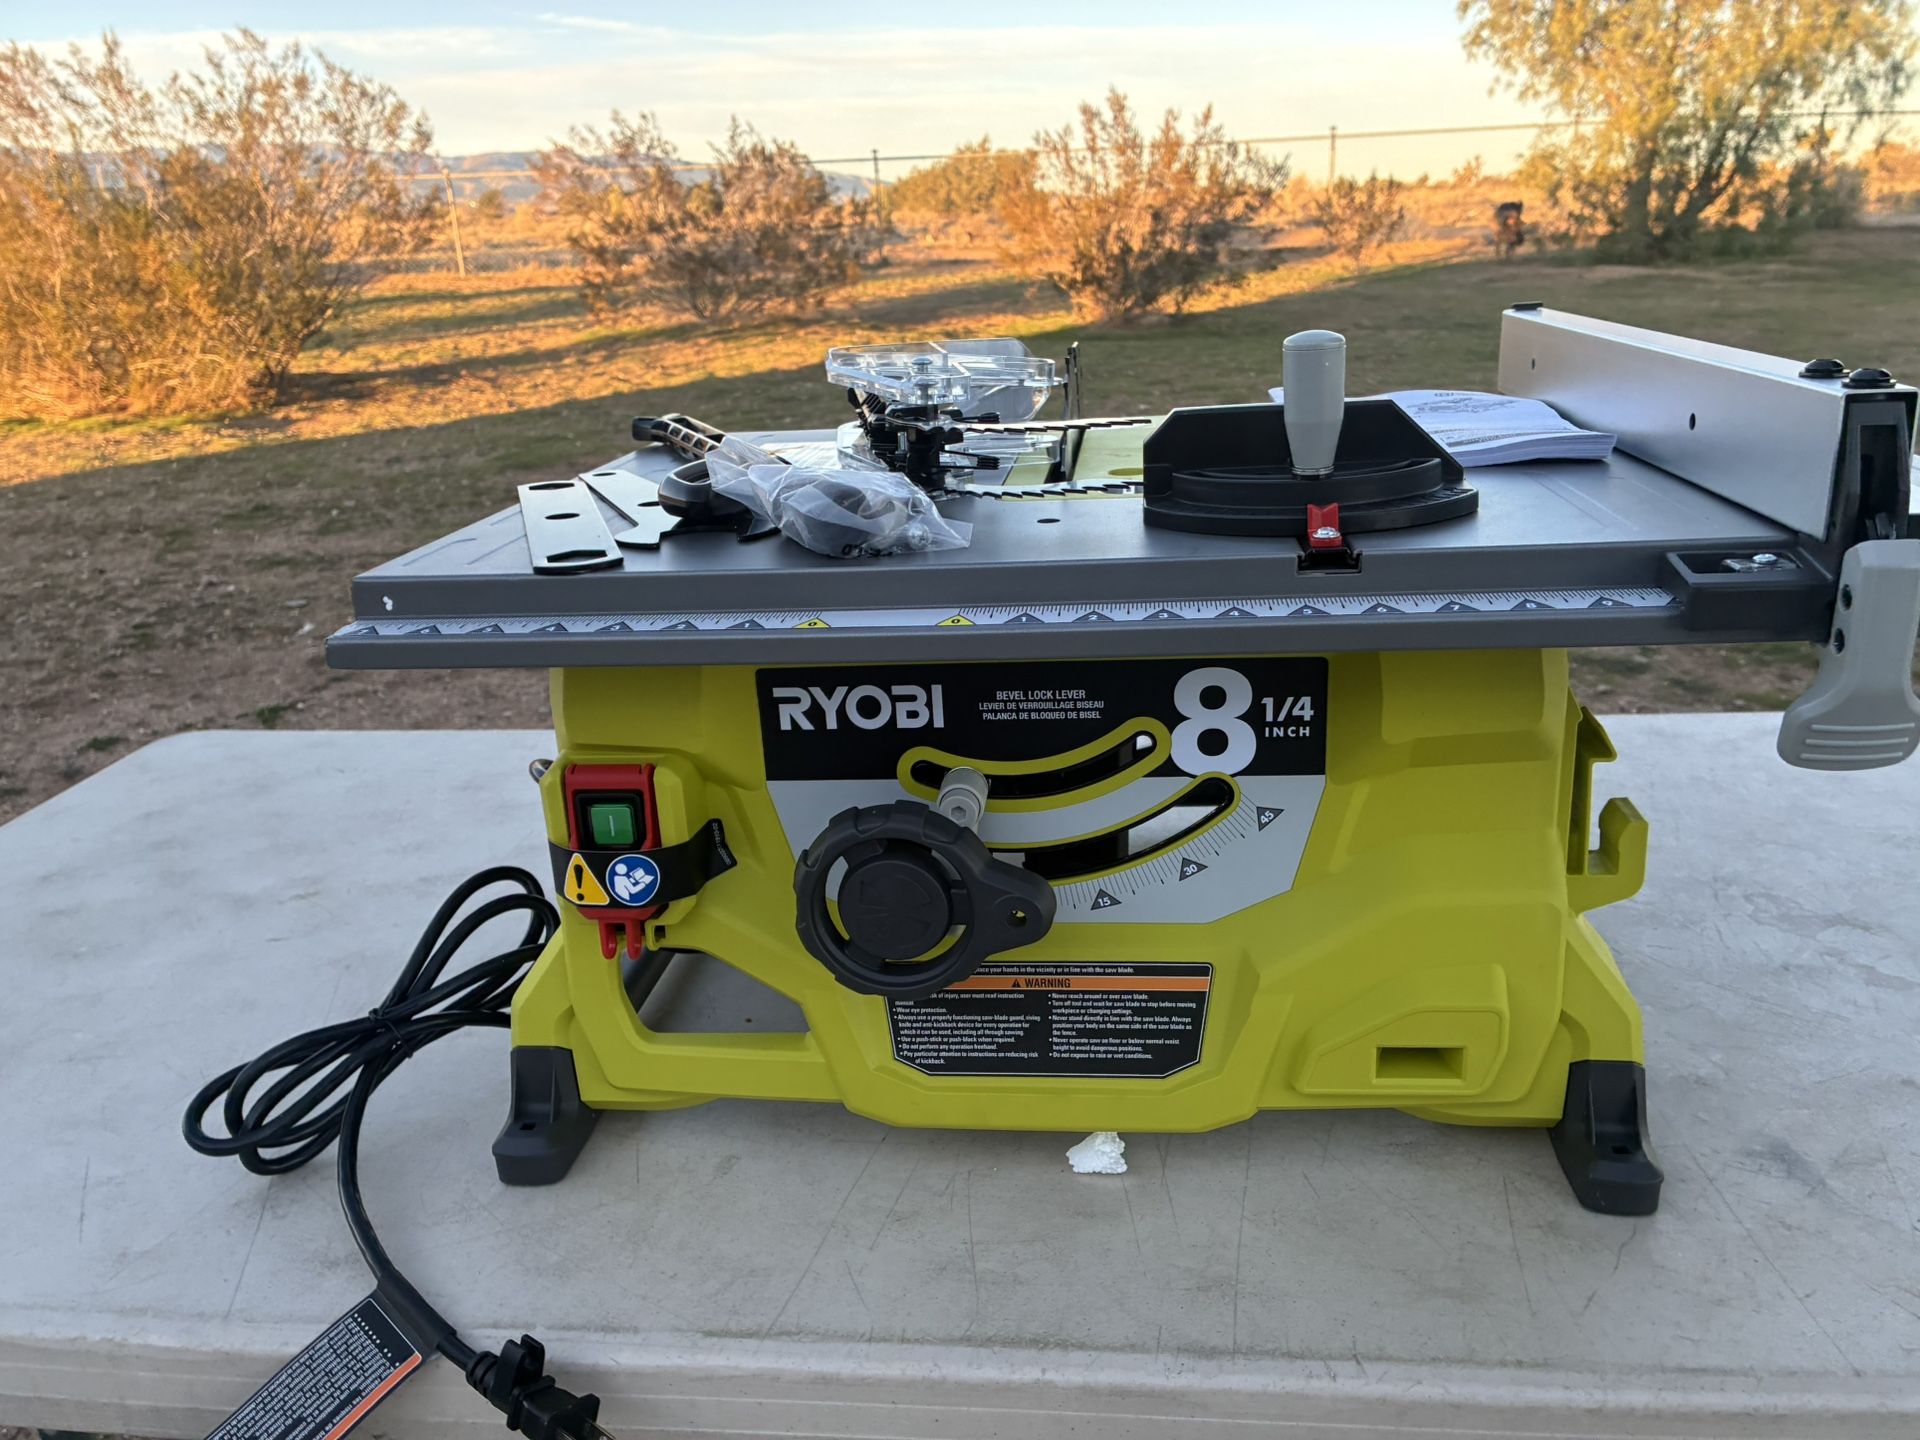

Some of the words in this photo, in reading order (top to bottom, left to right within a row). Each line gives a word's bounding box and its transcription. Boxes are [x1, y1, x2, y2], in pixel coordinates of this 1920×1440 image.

[996, 691, 1026, 700] BEVEL
[1028, 690, 1054, 700] LOCK
[1056, 689, 1086, 699] LEVER
[772, 685, 944, 731] RYOBI
[979, 702, 1004, 710] LEVIER
[1006, 702, 1017, 710] DE
[1018, 701, 1075, 709] VERROUILLAGE
[1076, 701, 1104, 709] BISEAU
[983, 712, 1017, 720] PALANCA
[1019, 712, 1029, 720] DE
[1031, 712, 1066, 720] BLOQUEO
[1067, 711, 1078, 719] DE
[1079, 711, 1102, 719] BISEL
[1170, 668, 1257, 777] 8
[1262, 696, 1314, 722] 1/4
[1265, 726, 1311, 738] INCH
[1260, 811, 1275, 825] 45
[1183, 864, 1197, 876] 30
[1097, 896, 1111, 907] 15
[1036, 966, 1056, 974] vicinity
[1024, 978, 1071, 988] WARNING
